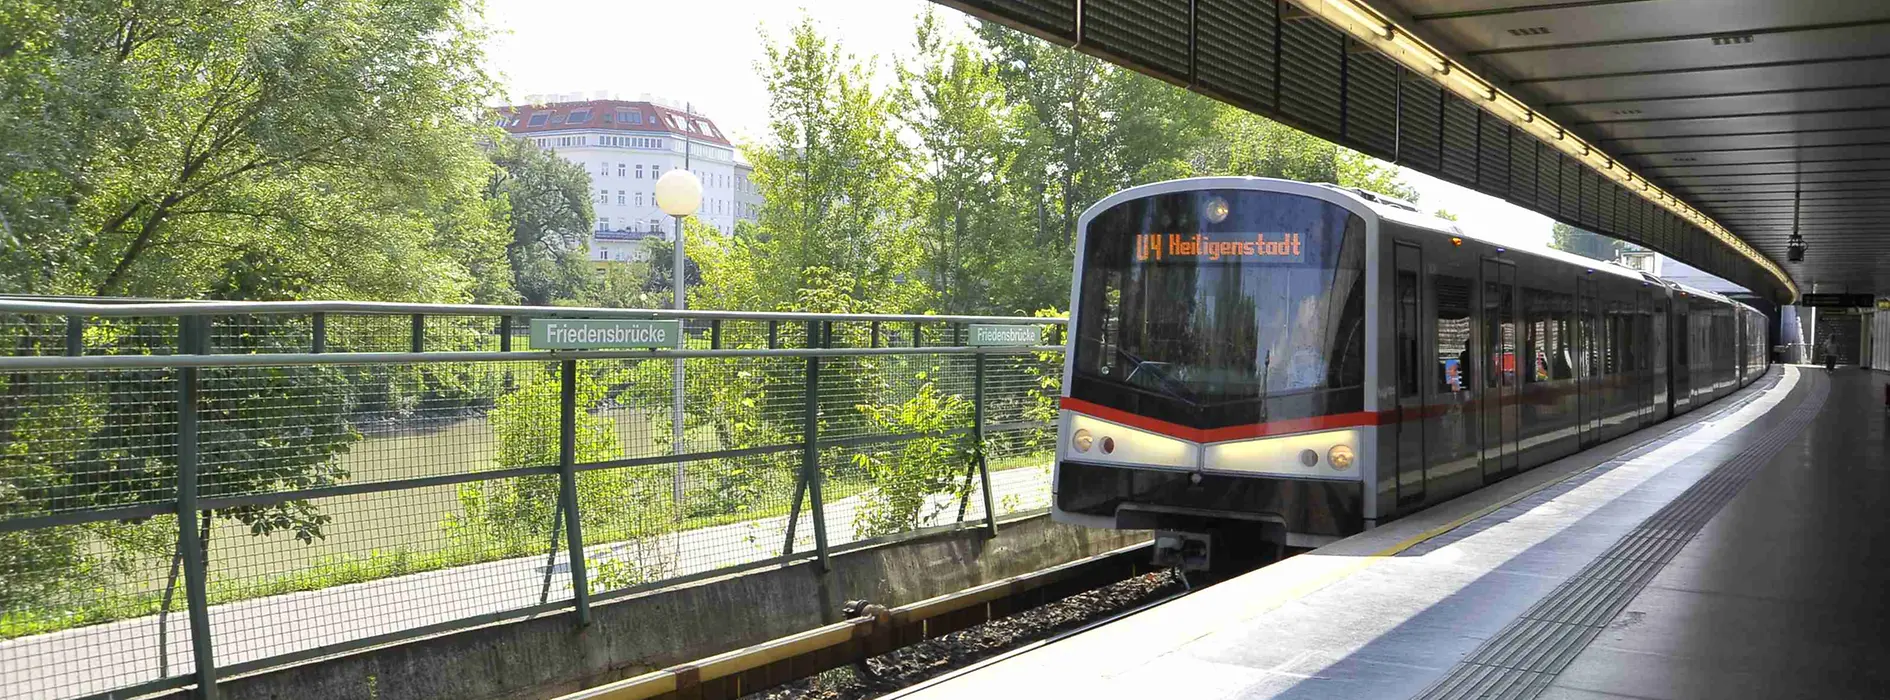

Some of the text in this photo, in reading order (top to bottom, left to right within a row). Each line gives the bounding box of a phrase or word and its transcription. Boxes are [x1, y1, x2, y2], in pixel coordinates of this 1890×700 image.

[1136, 233, 1300, 260] U4 Heiligenstadt
[546, 323, 666, 343] Friedensbrücke
[977, 327, 1036, 342] Friedensbrücke
